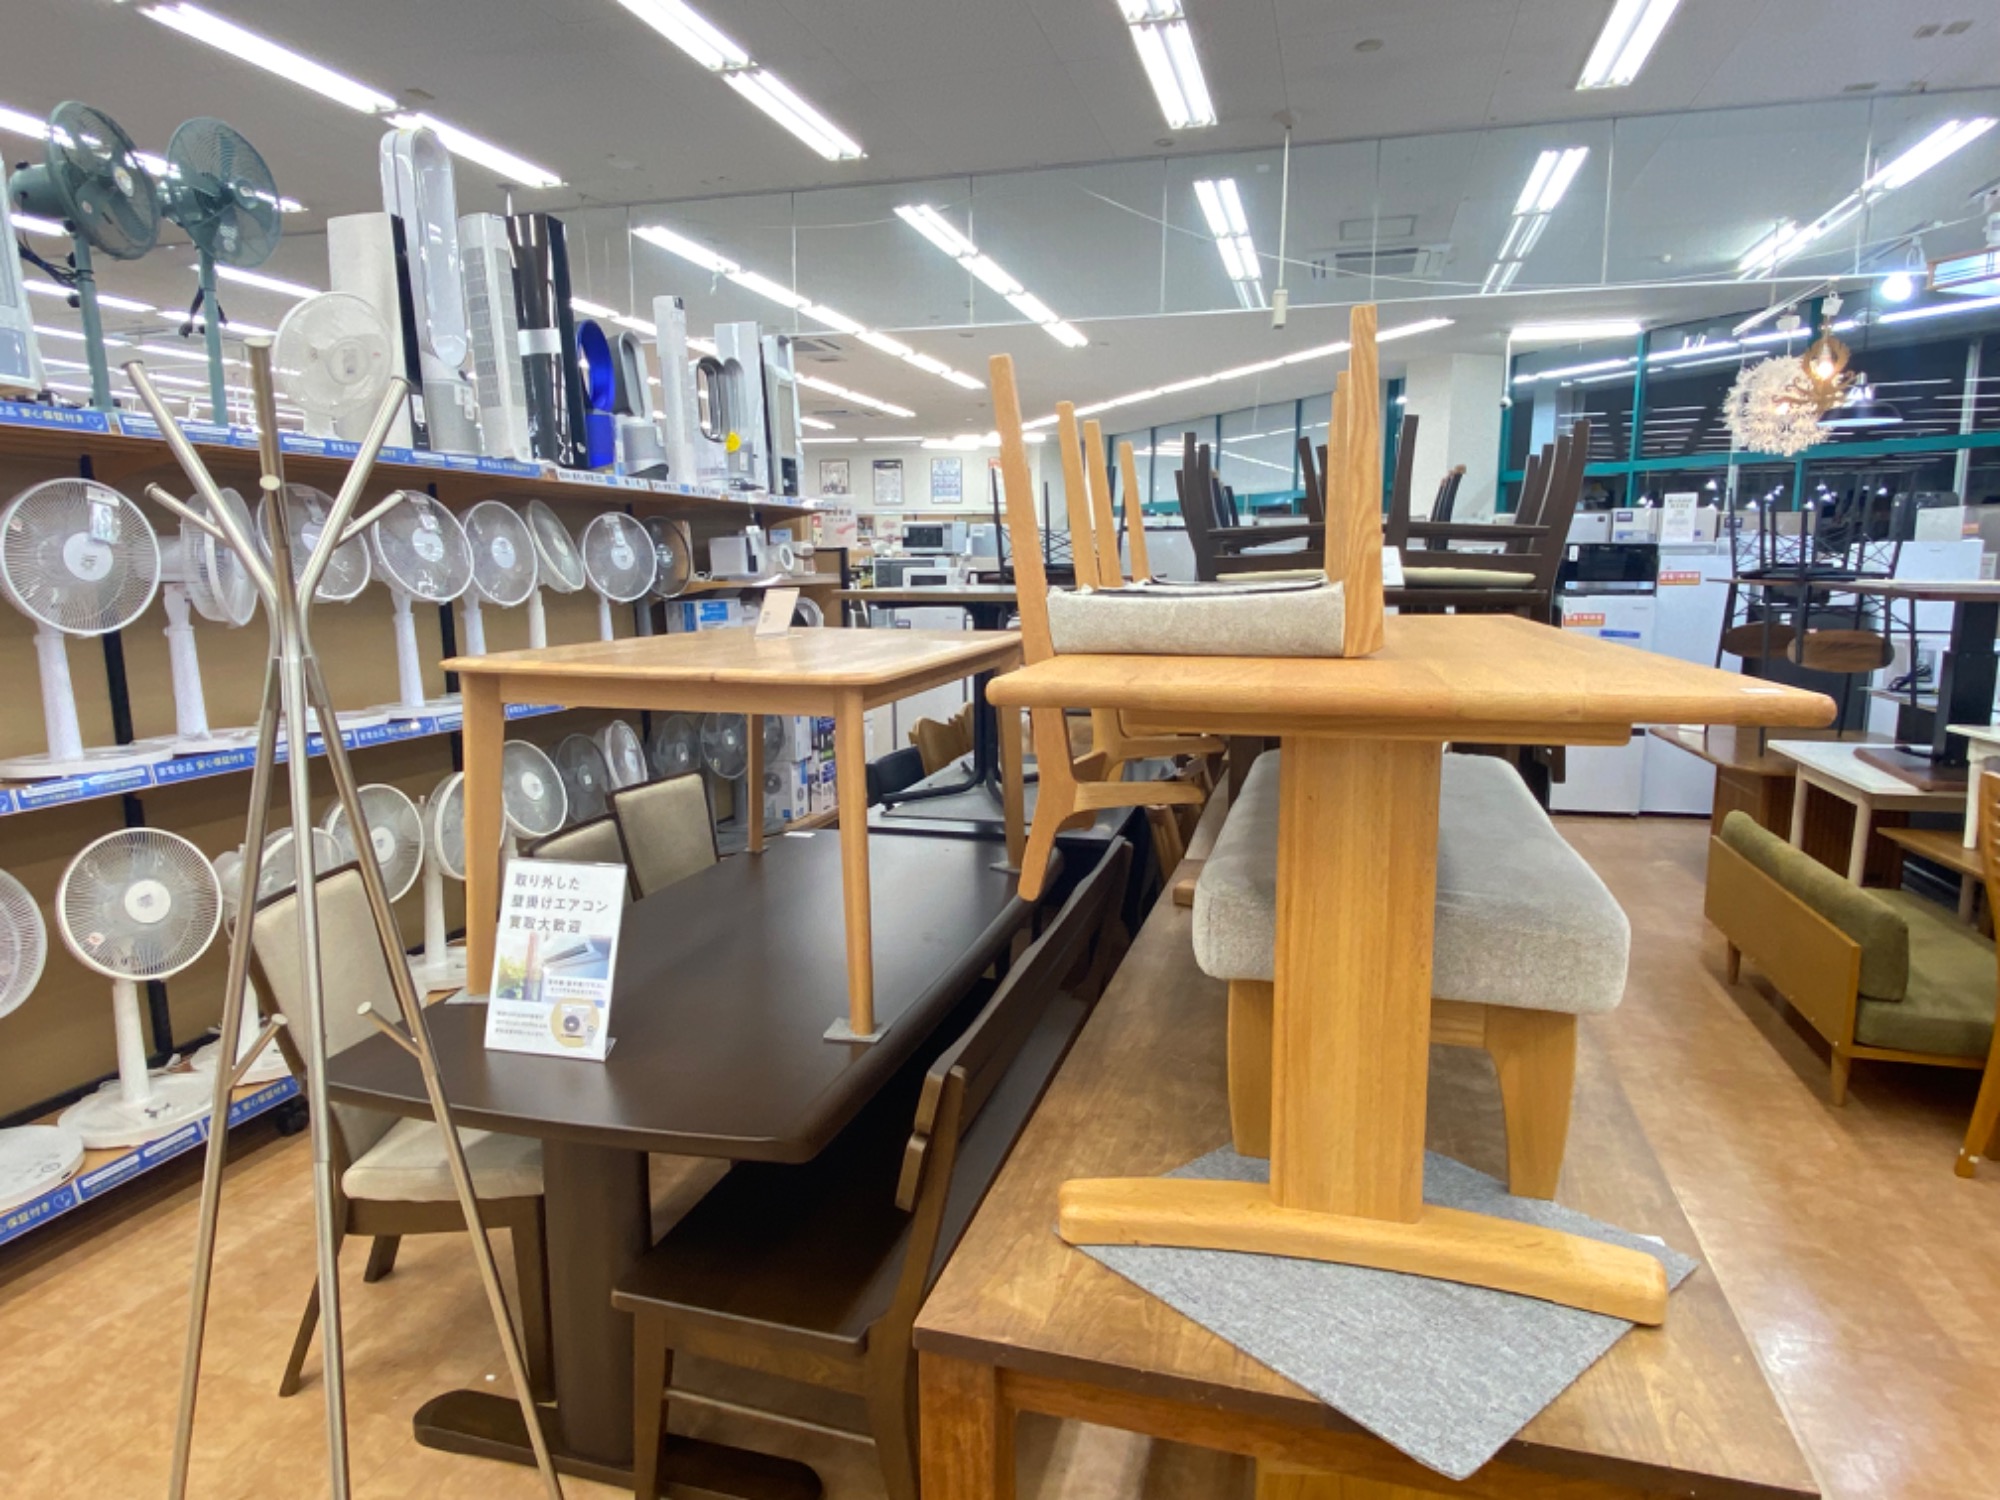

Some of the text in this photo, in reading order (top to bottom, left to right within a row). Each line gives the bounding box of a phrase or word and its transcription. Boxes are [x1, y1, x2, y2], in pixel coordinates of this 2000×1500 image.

[515, 872, 580, 891] 取り外した
[511, 894, 609, 914] 壁掛けエアコン
[509, 915, 583, 934] 買取大歓迎
